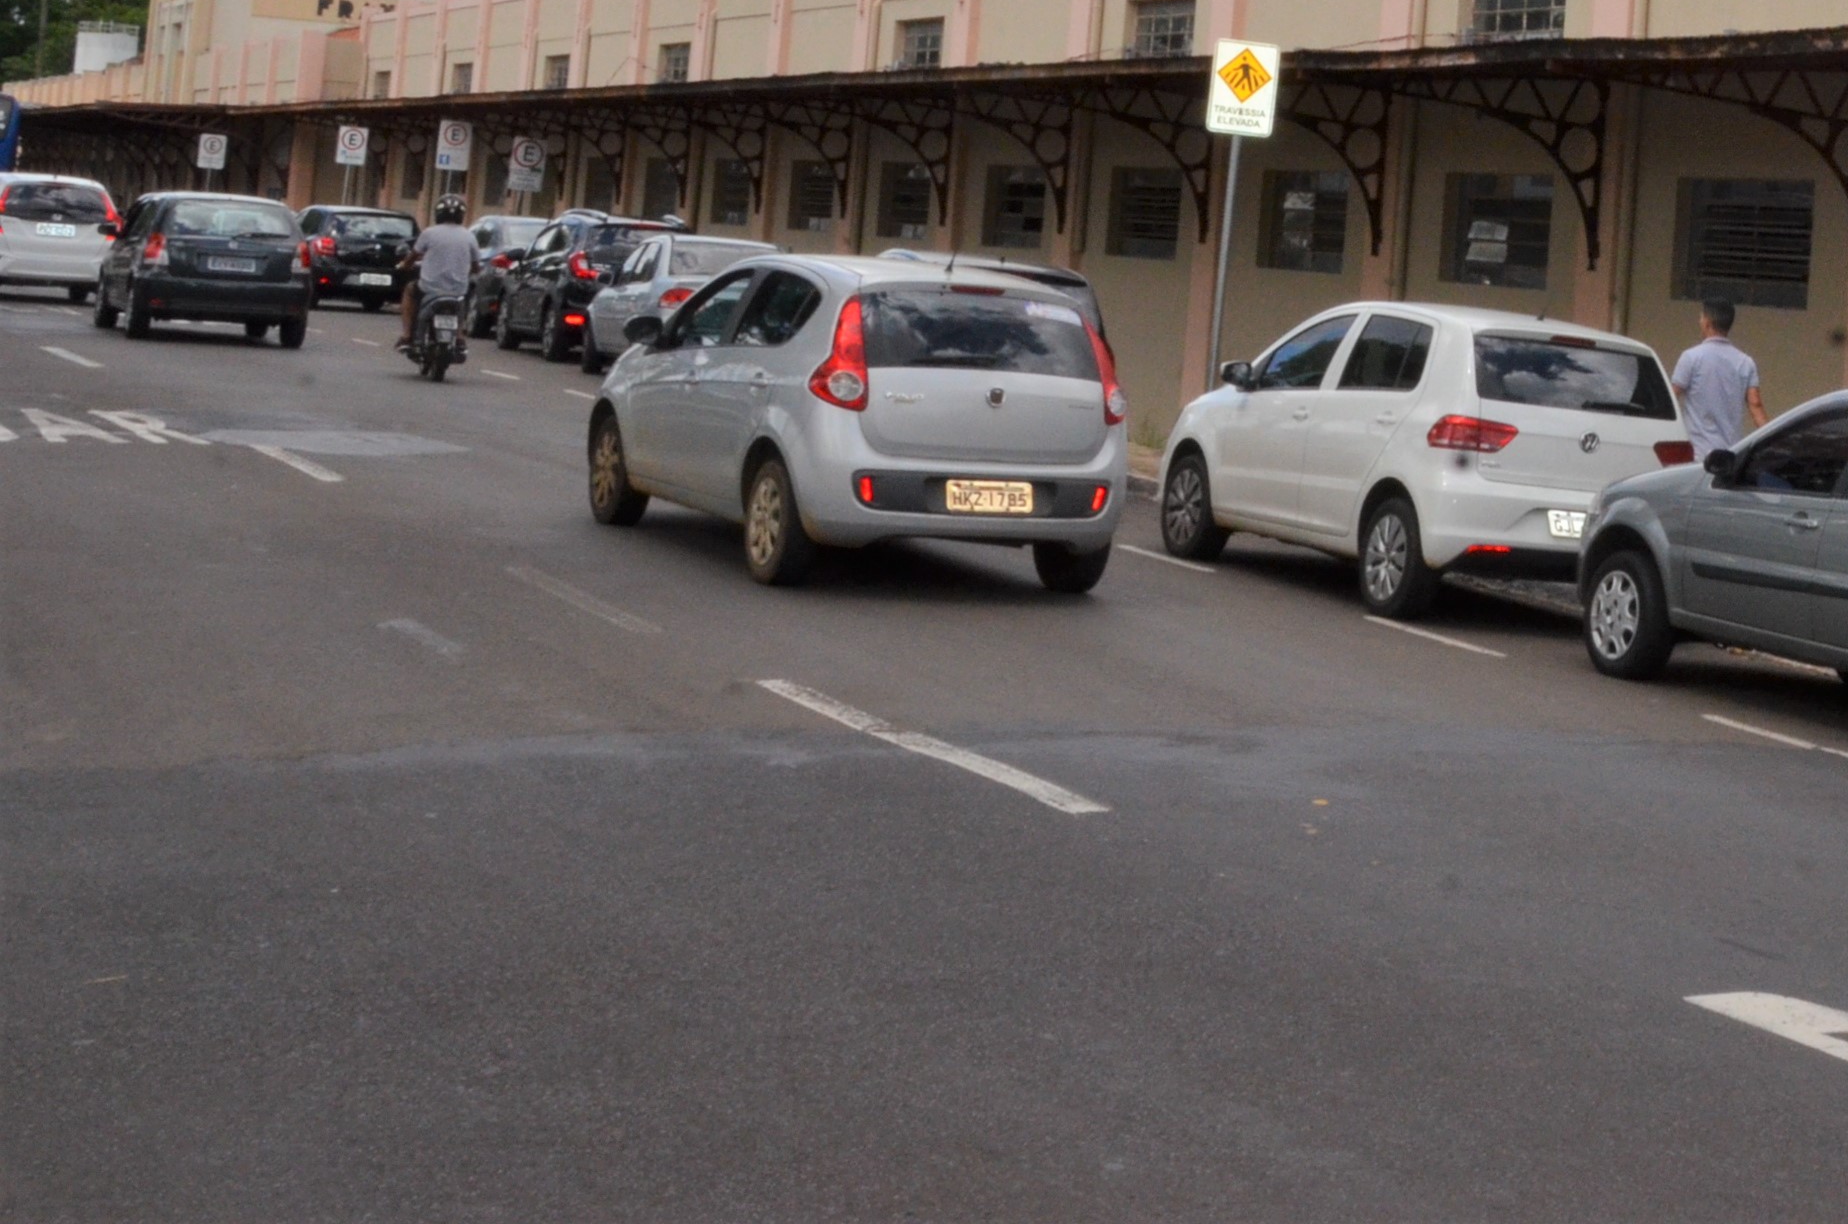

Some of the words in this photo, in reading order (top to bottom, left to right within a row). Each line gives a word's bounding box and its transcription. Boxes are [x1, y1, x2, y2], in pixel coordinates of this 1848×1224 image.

[1214, 104, 1266, 118] TRAVESSIA
[1217, 115, 1261, 128] ELEVADA
[348, 133, 357, 146] E
[451, 128, 460, 141] E
[209, 140, 217, 152] E
[523, 145, 536, 162] E
[0, 408, 212, 444] AR
